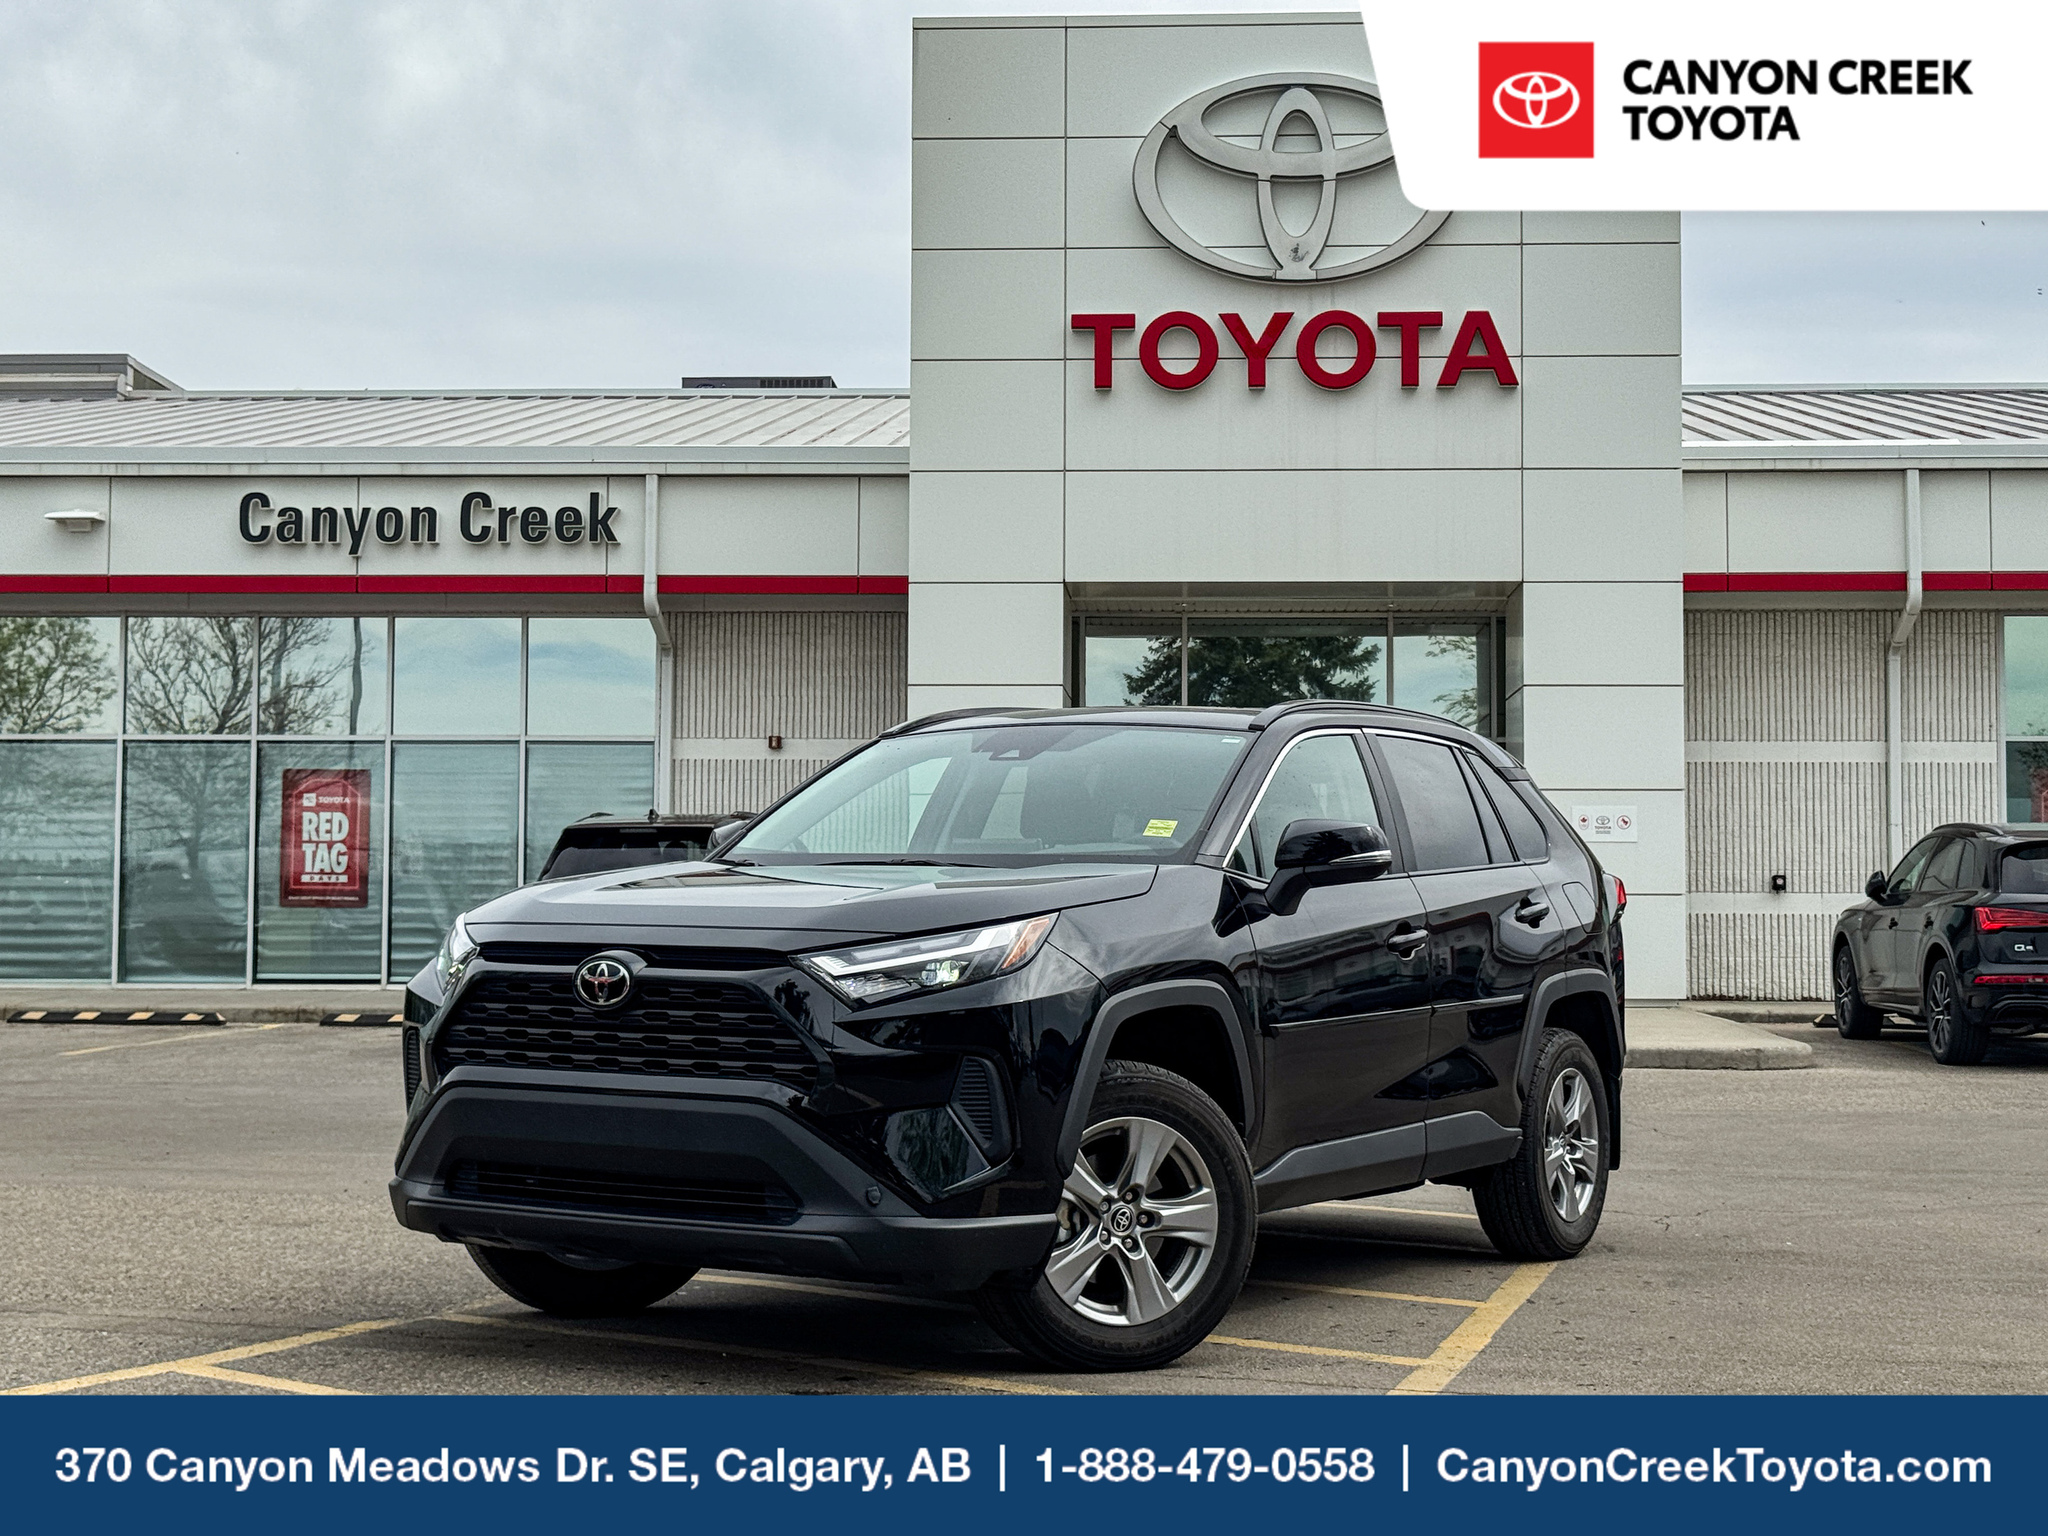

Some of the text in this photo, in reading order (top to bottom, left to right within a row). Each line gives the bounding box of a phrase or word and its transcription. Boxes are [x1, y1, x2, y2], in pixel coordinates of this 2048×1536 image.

[1072, 310, 1519, 391] TOYOTA
[239, 491, 620, 558] Canyon Creek
[318, 796, 350, 804] TOYOTA
[302, 811, 349, 842] RED
[302, 843, 349, 874] TAG
